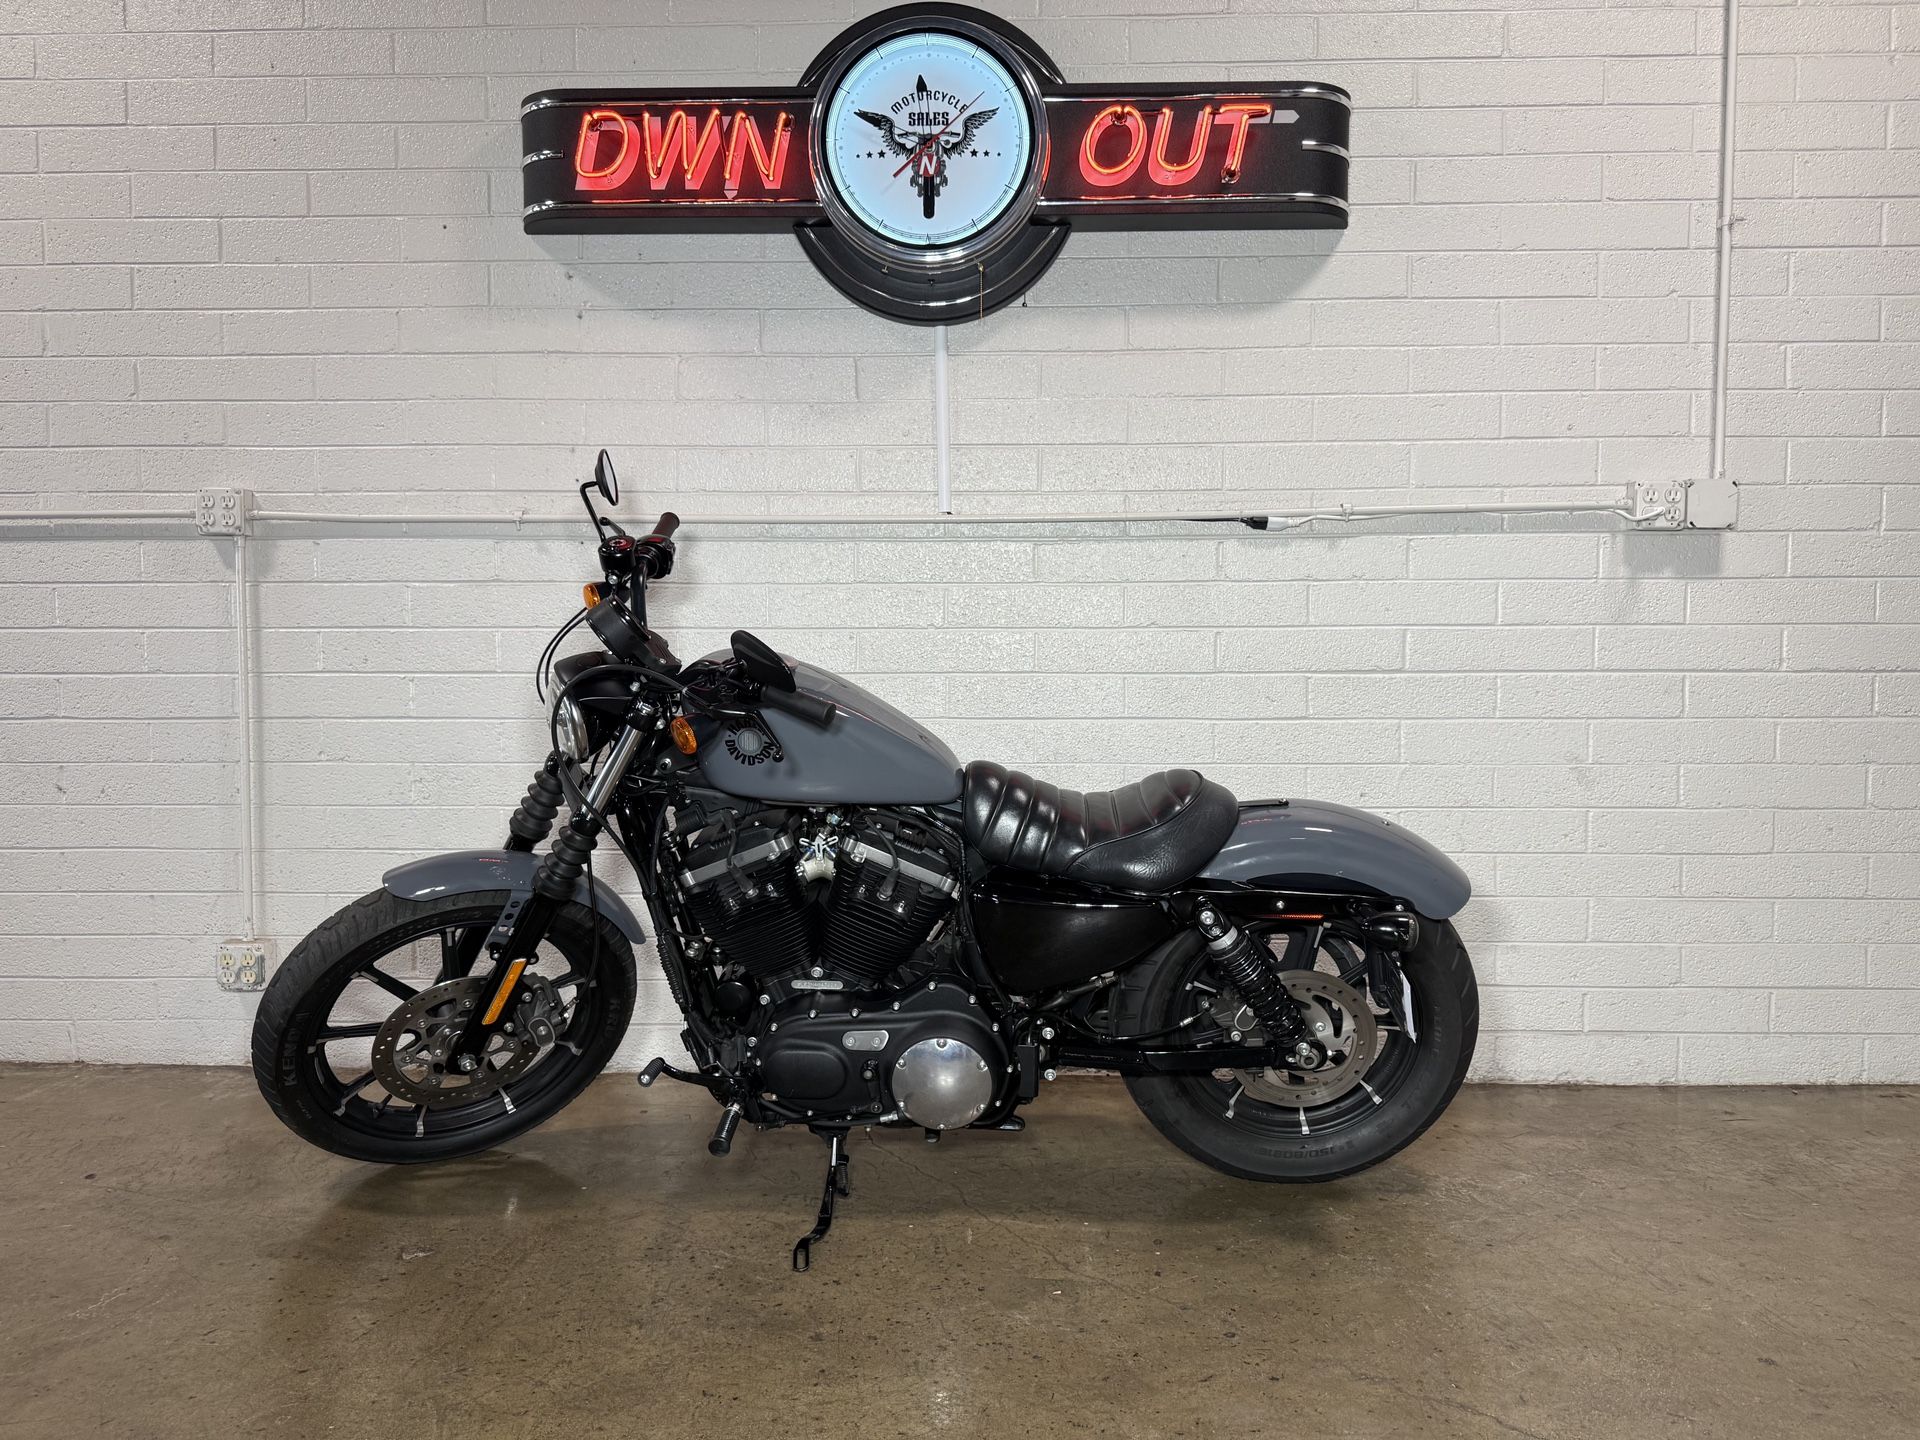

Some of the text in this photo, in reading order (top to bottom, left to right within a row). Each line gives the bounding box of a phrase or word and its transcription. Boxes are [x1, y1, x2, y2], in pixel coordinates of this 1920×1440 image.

[890, 89, 969, 115] MOTORCYCLE
[908, 112, 950, 126] SALES
[1078, 103, 1273, 187] OUT
[919, 156, 937, 174] N
[725, 740, 775, 766] DAVIDSON
